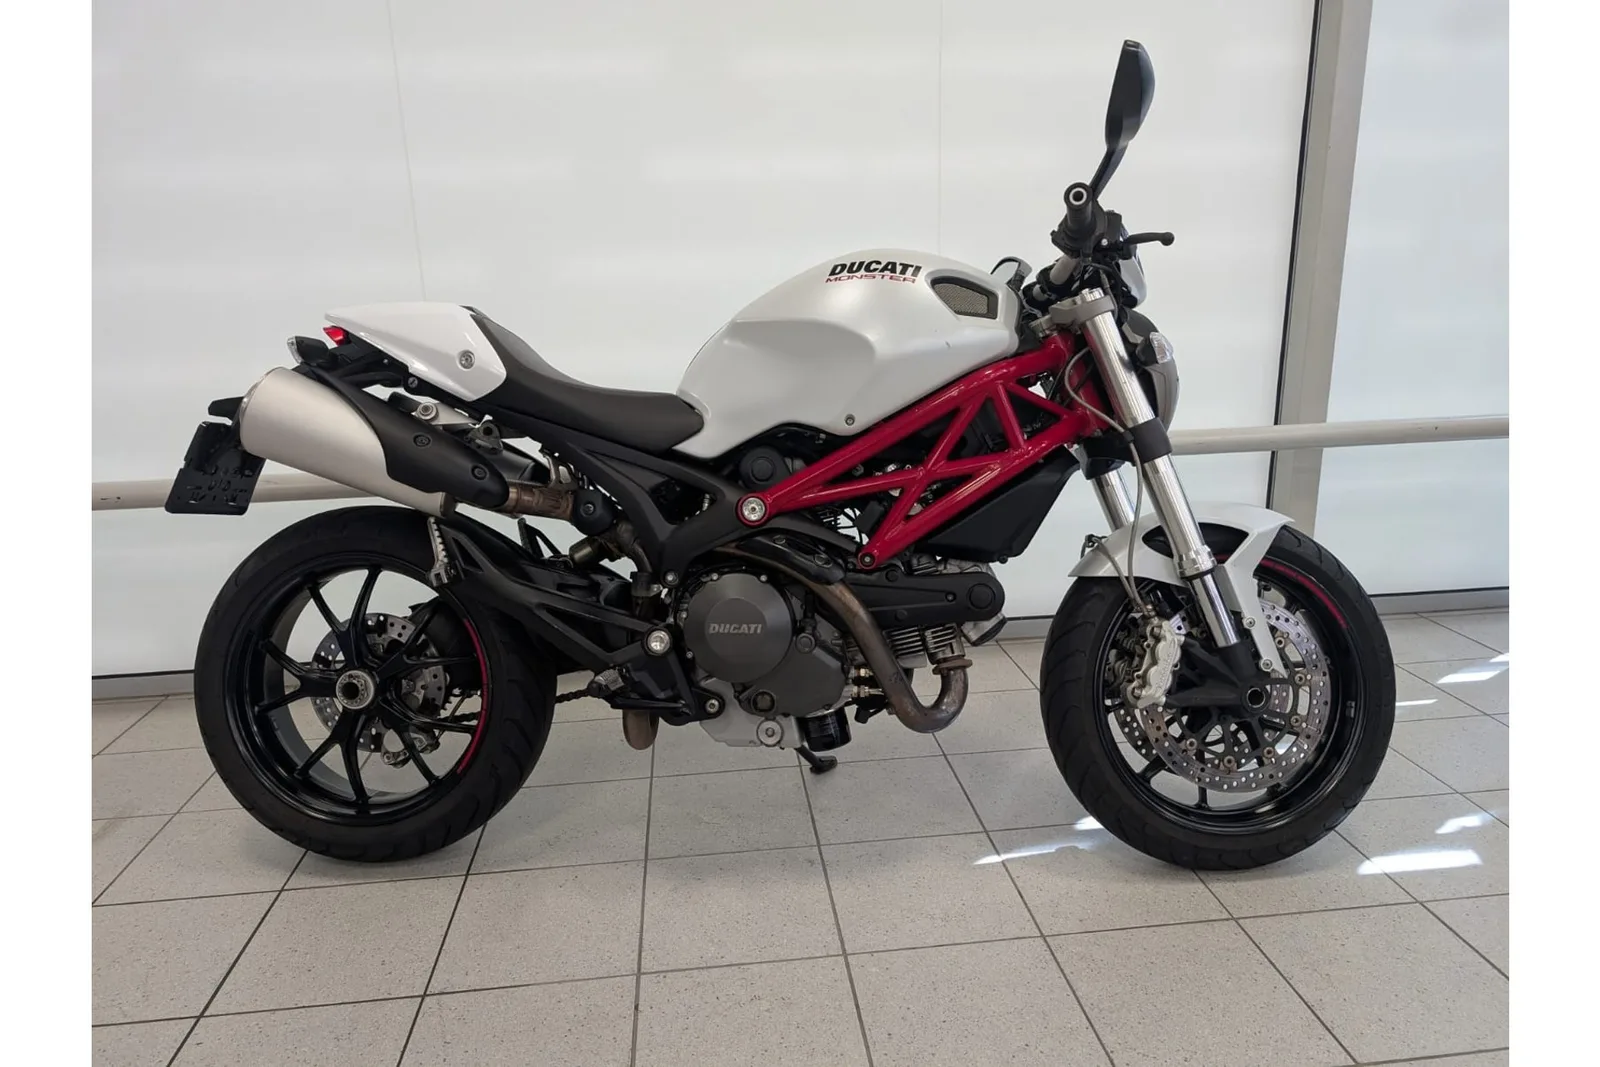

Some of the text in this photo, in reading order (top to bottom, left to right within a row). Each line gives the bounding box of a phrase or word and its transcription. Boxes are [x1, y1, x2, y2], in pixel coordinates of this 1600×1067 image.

[828, 260, 922, 277] DUCATI
[825, 273, 917, 284] MONSTER
[709, 623, 762, 635] DUCATI
